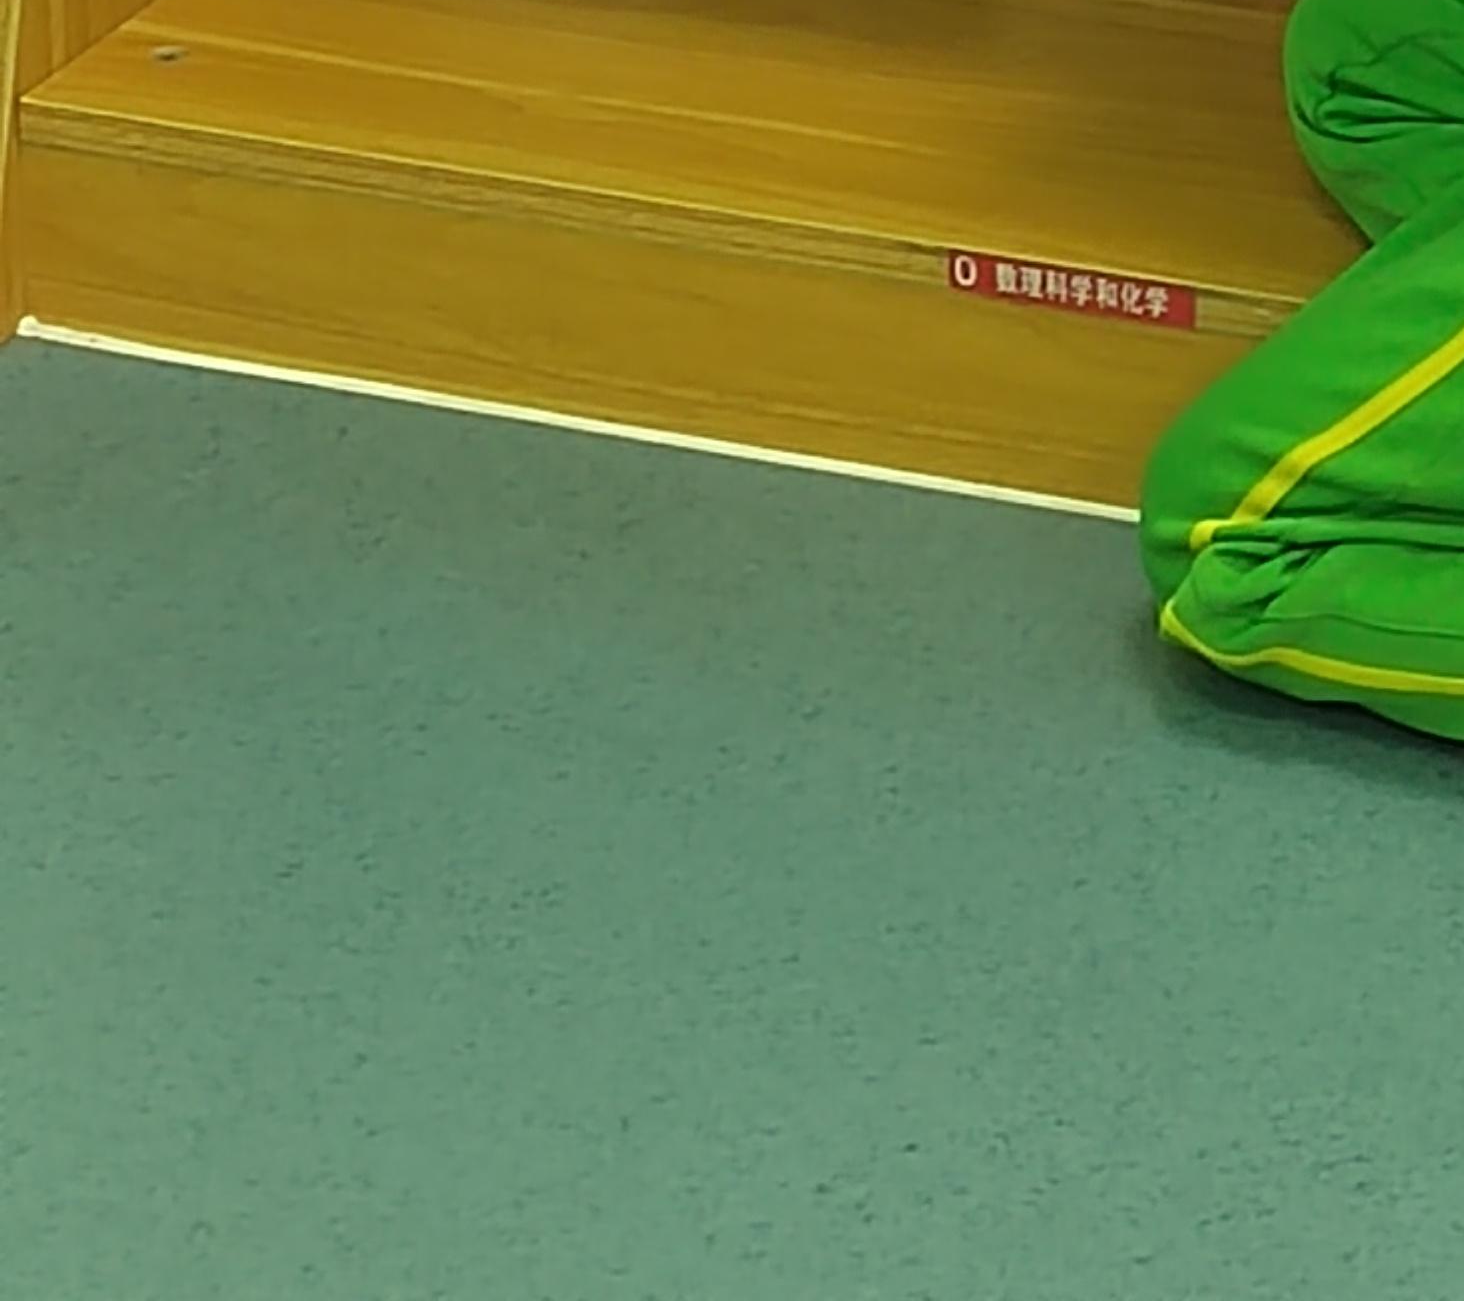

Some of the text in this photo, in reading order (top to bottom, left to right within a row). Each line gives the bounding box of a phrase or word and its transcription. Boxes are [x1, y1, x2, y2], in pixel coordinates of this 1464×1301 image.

[994, 264, 1172, 319] 数理科学和化学
